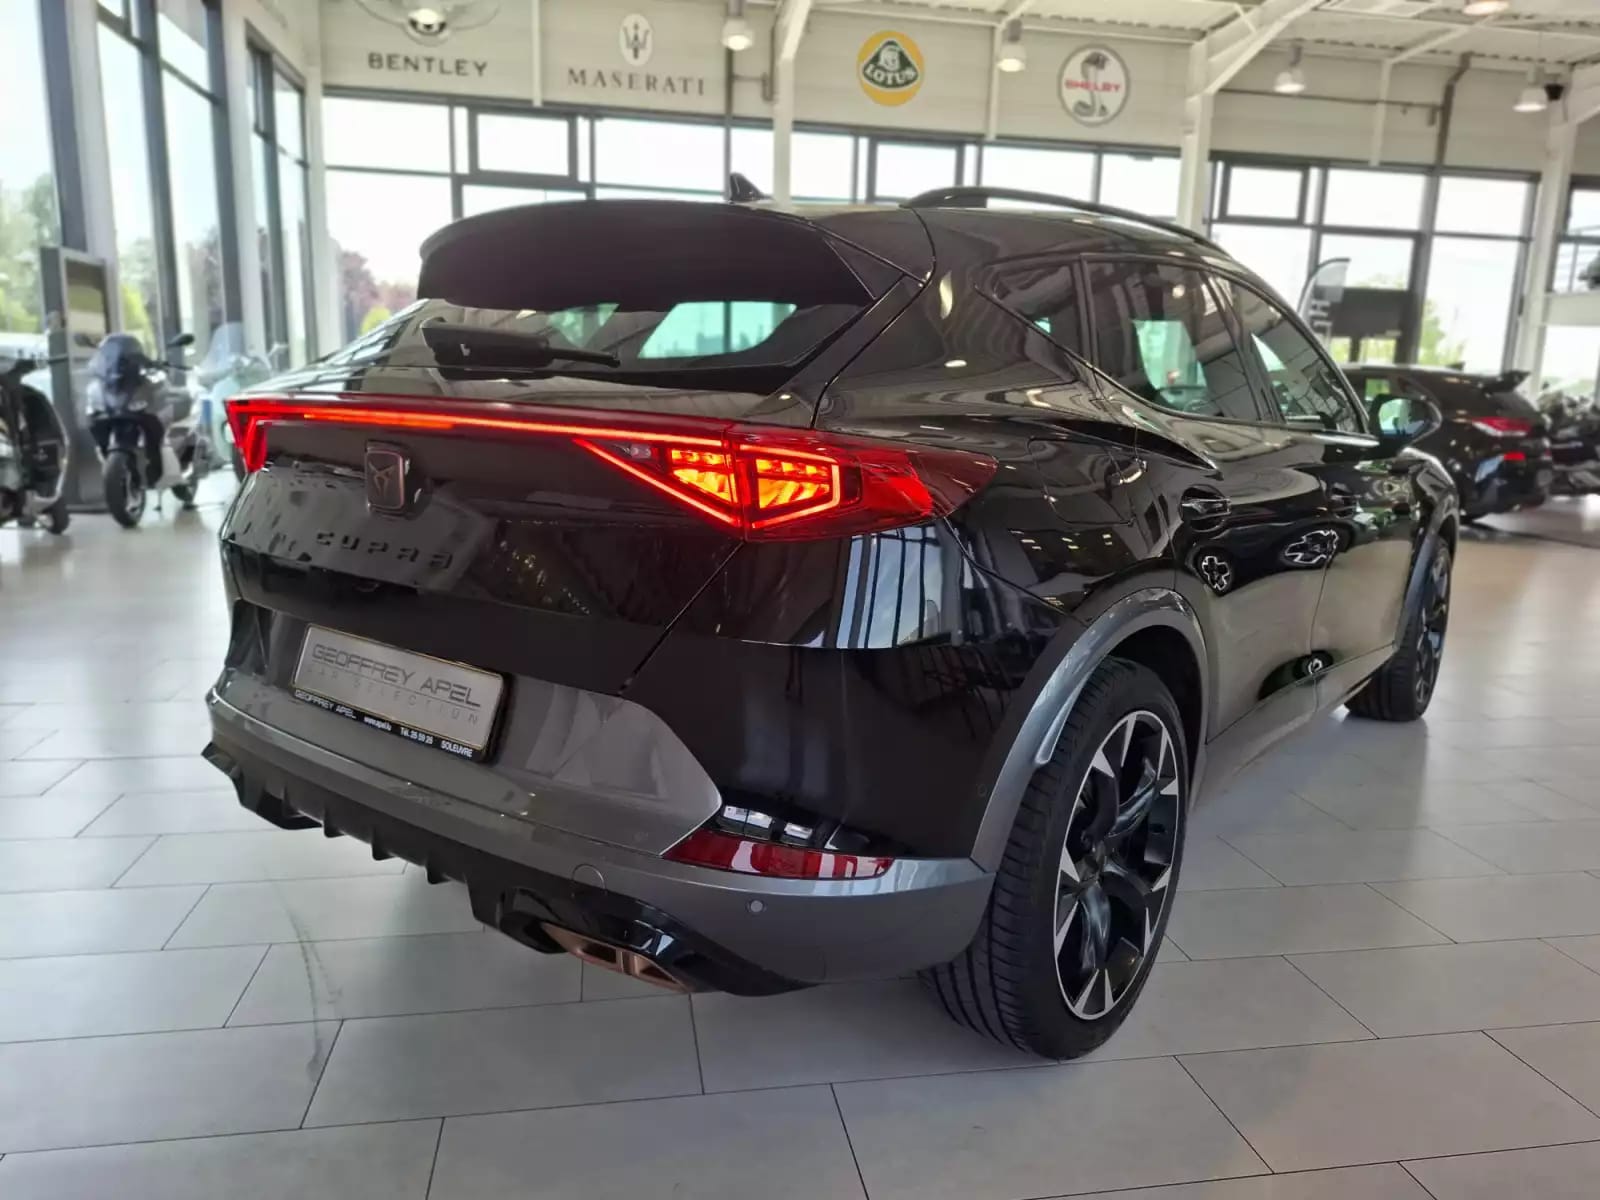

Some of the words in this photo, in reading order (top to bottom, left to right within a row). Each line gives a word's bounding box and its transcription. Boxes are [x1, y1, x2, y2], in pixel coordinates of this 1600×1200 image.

[367, 51, 488, 77] BENTLEY
[865, 63, 917, 85] LOTUS
[567, 67, 704, 97] MASERATI
[1064, 79, 1120, 93] SHELBY
[316, 531, 453, 569] CUPRA
[312, 643, 416, 684] GEOFFREY
[420, 677, 481, 708] APEL
[294, 689, 334, 710] GEOFFREY
[335, 703, 357, 719] APEL
[440, 739, 473, 758] SOLEUVRE
